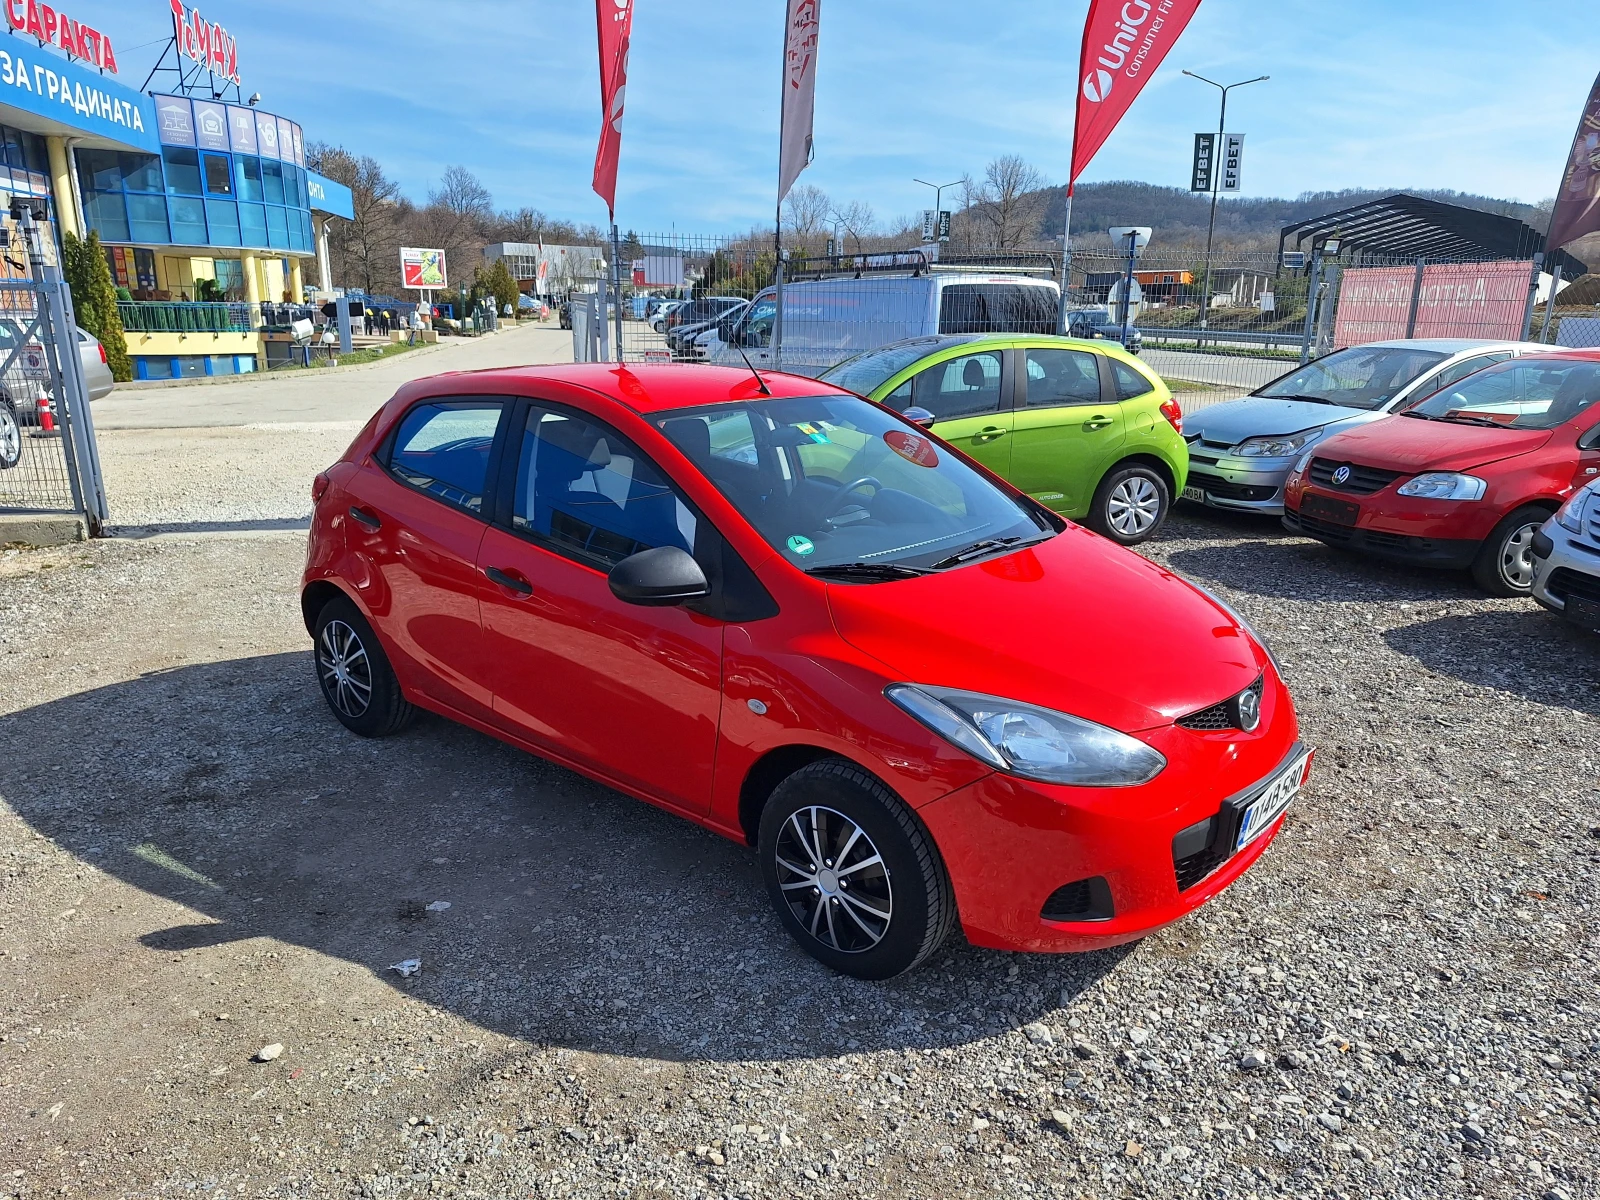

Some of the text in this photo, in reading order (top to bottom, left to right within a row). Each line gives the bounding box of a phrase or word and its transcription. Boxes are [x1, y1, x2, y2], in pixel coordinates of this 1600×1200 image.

[1125, 14, 1165, 78] Consumer
[0, 50, 145, 133] ЗА ГРАДИНАТА
[1196, 137, 1210, 188] EFBET
[1225, 137, 1239, 188] EFBET
